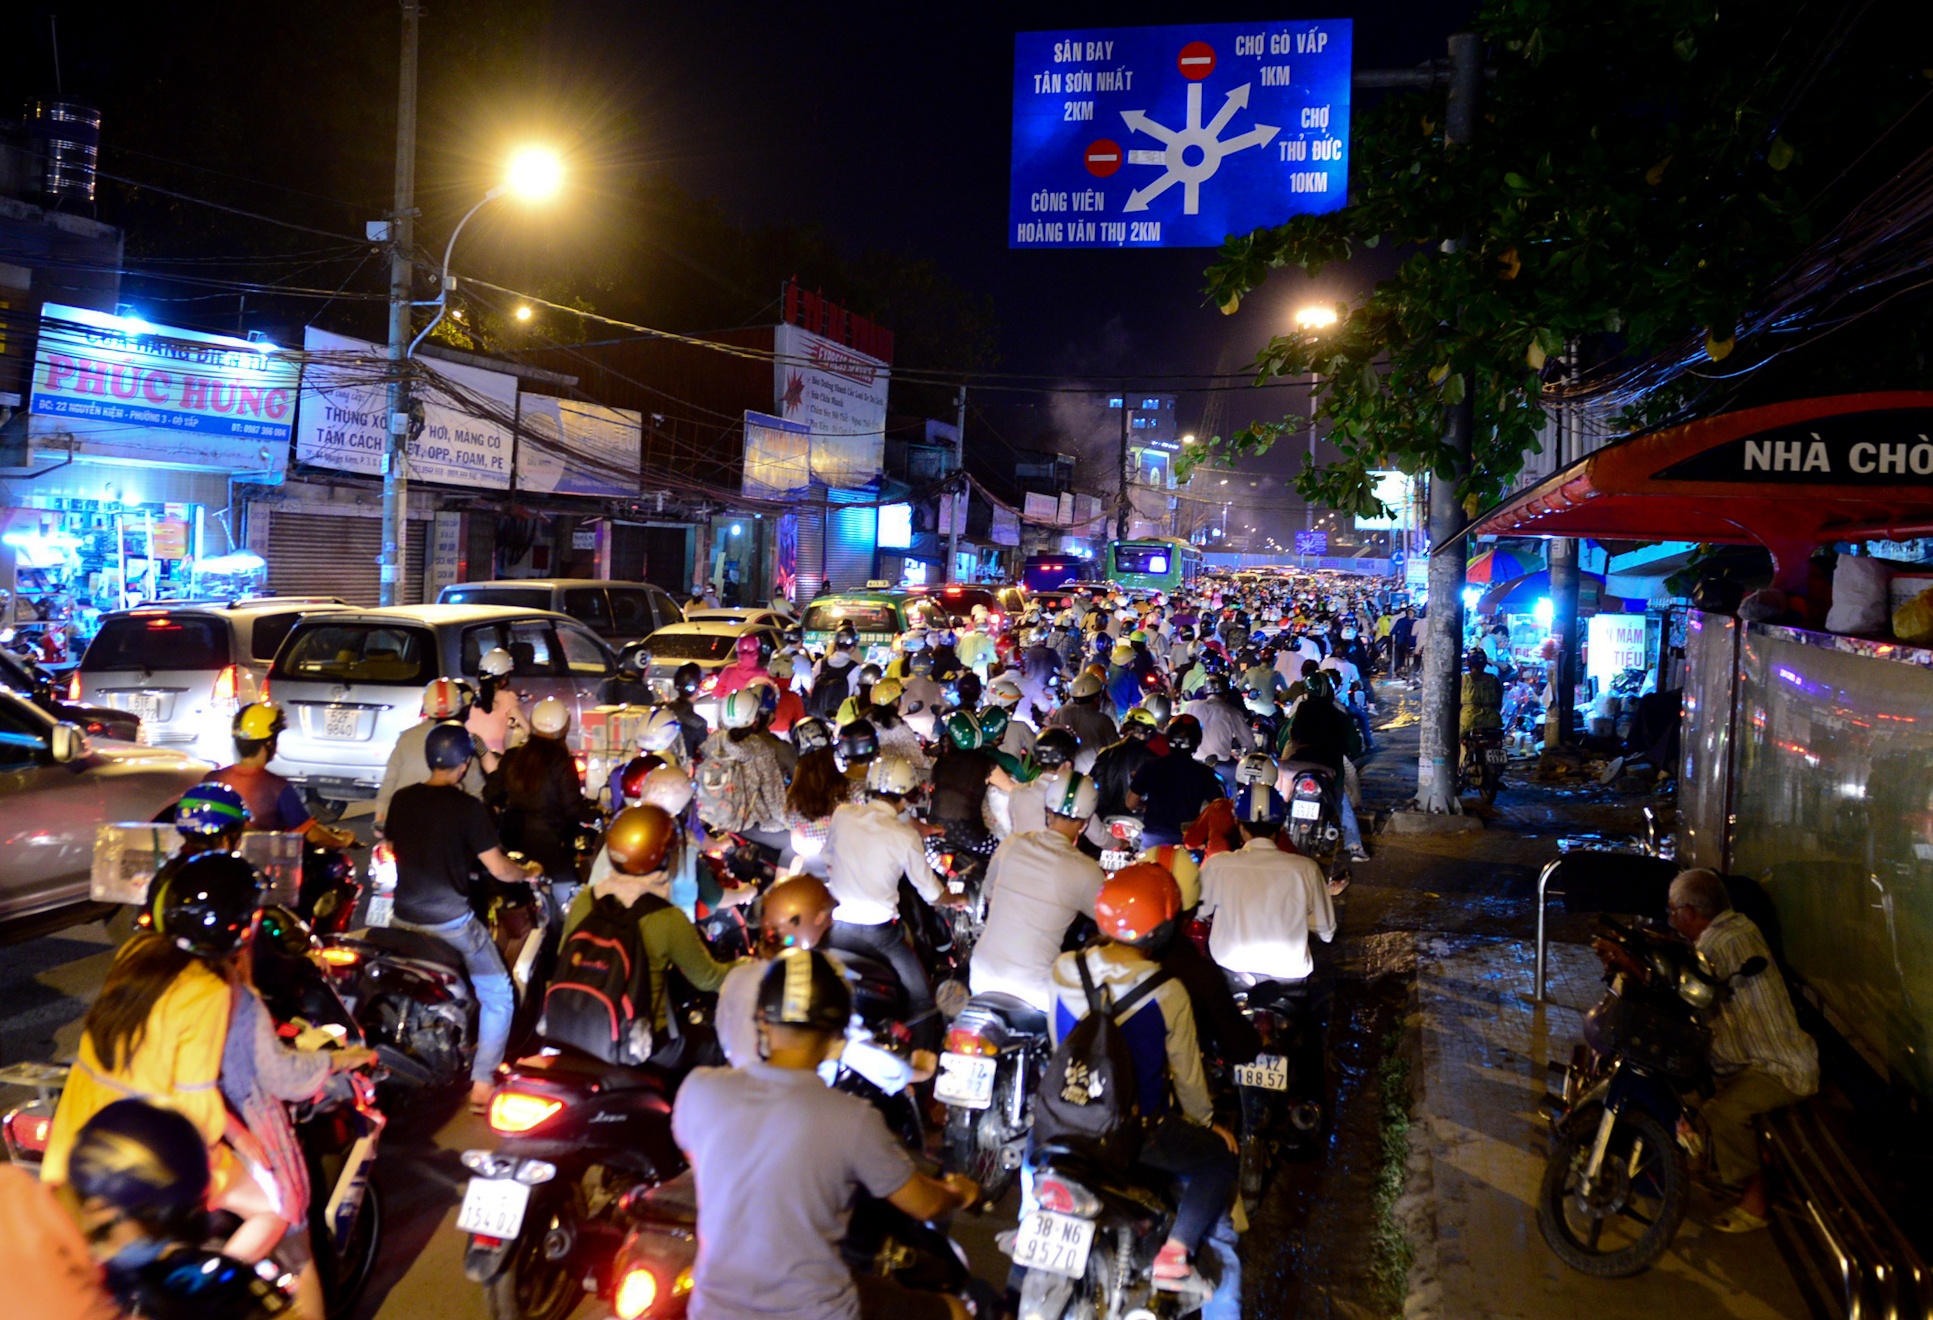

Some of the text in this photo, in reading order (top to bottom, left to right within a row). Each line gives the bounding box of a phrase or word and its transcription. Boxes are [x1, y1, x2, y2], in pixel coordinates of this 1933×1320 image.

[1054, 39, 1114, 63] SÂN BAY
[1235, 26, 1329, 61] CHỢ GÒ VẤP
[1034, 65, 1133, 94] TÂN SƠN NHẤT
[1260, 65, 1291, 87] 1KM
[1063, 101, 1094, 122] 2KM
[1301, 104, 1331, 132] CHỢ
[1279, 132, 1342, 162] THỦ ĐỨC
[1289, 172, 1328, 193] 10KM
[1031, 188, 1105, 212] CÔNG VIÊN
[1017, 218, 1161, 247] HOÀNG VĂN THỤ 2KM
[44, 354, 289, 420] PHÚC HƯNG
[325, 406, 368, 427] THÙNG
[317, 425, 382, 451] TẤM CÁCH
[487, 435, 501, 449] CO
[428, 446, 452, 463] OPP,
[456, 450, 488, 469] FOAM,
[491, 456, 504, 469] PE
[1744, 432, 1831, 472] NHÀ
[1025, 1239, 1077, 1270] 9570
